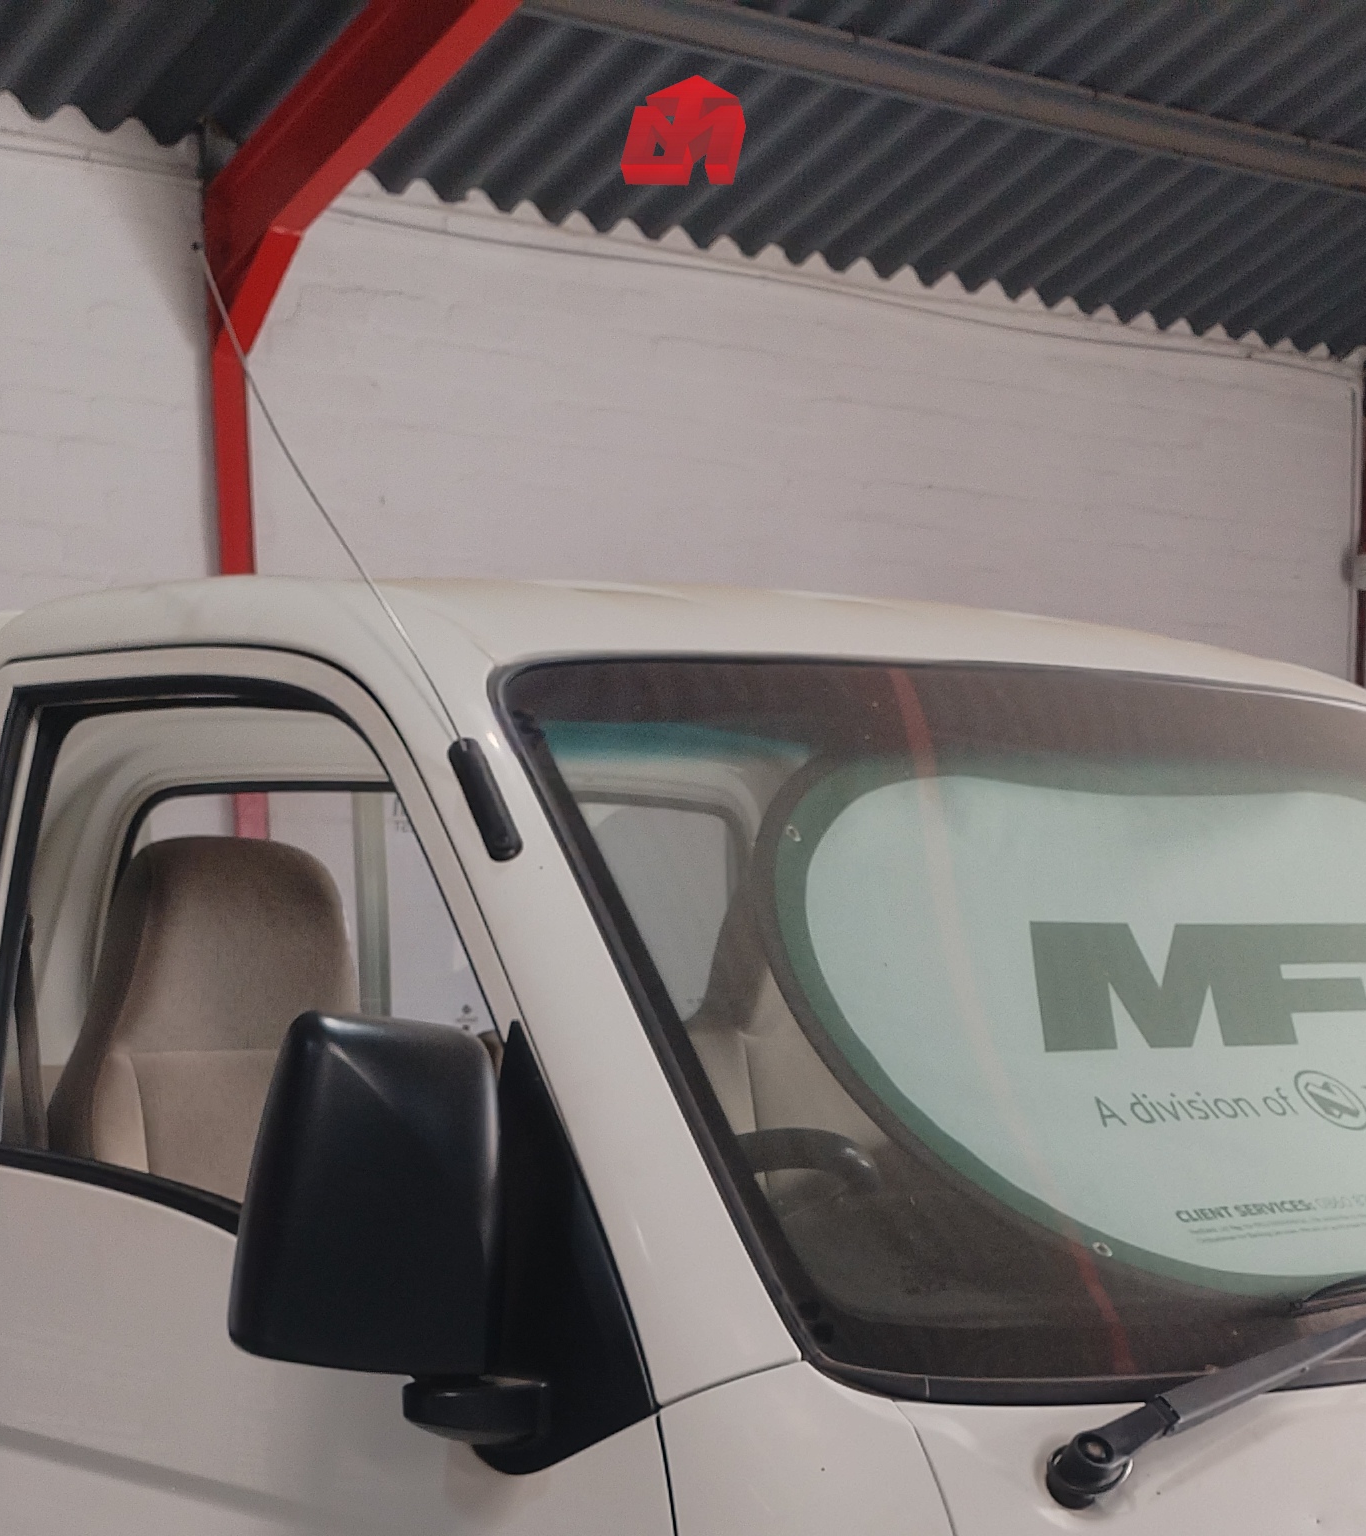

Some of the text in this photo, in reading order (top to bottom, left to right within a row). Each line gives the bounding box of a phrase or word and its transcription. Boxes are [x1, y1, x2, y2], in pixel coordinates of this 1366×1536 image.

[1094, 1096, 1127, 1128] A
[1134, 1092, 1261, 1125] division
[1265, 1087, 1300, 1116] of
[1175, 1205, 1234, 1223] CLIENT
[1234, 1199, 1316, 1218] SERVICES:
